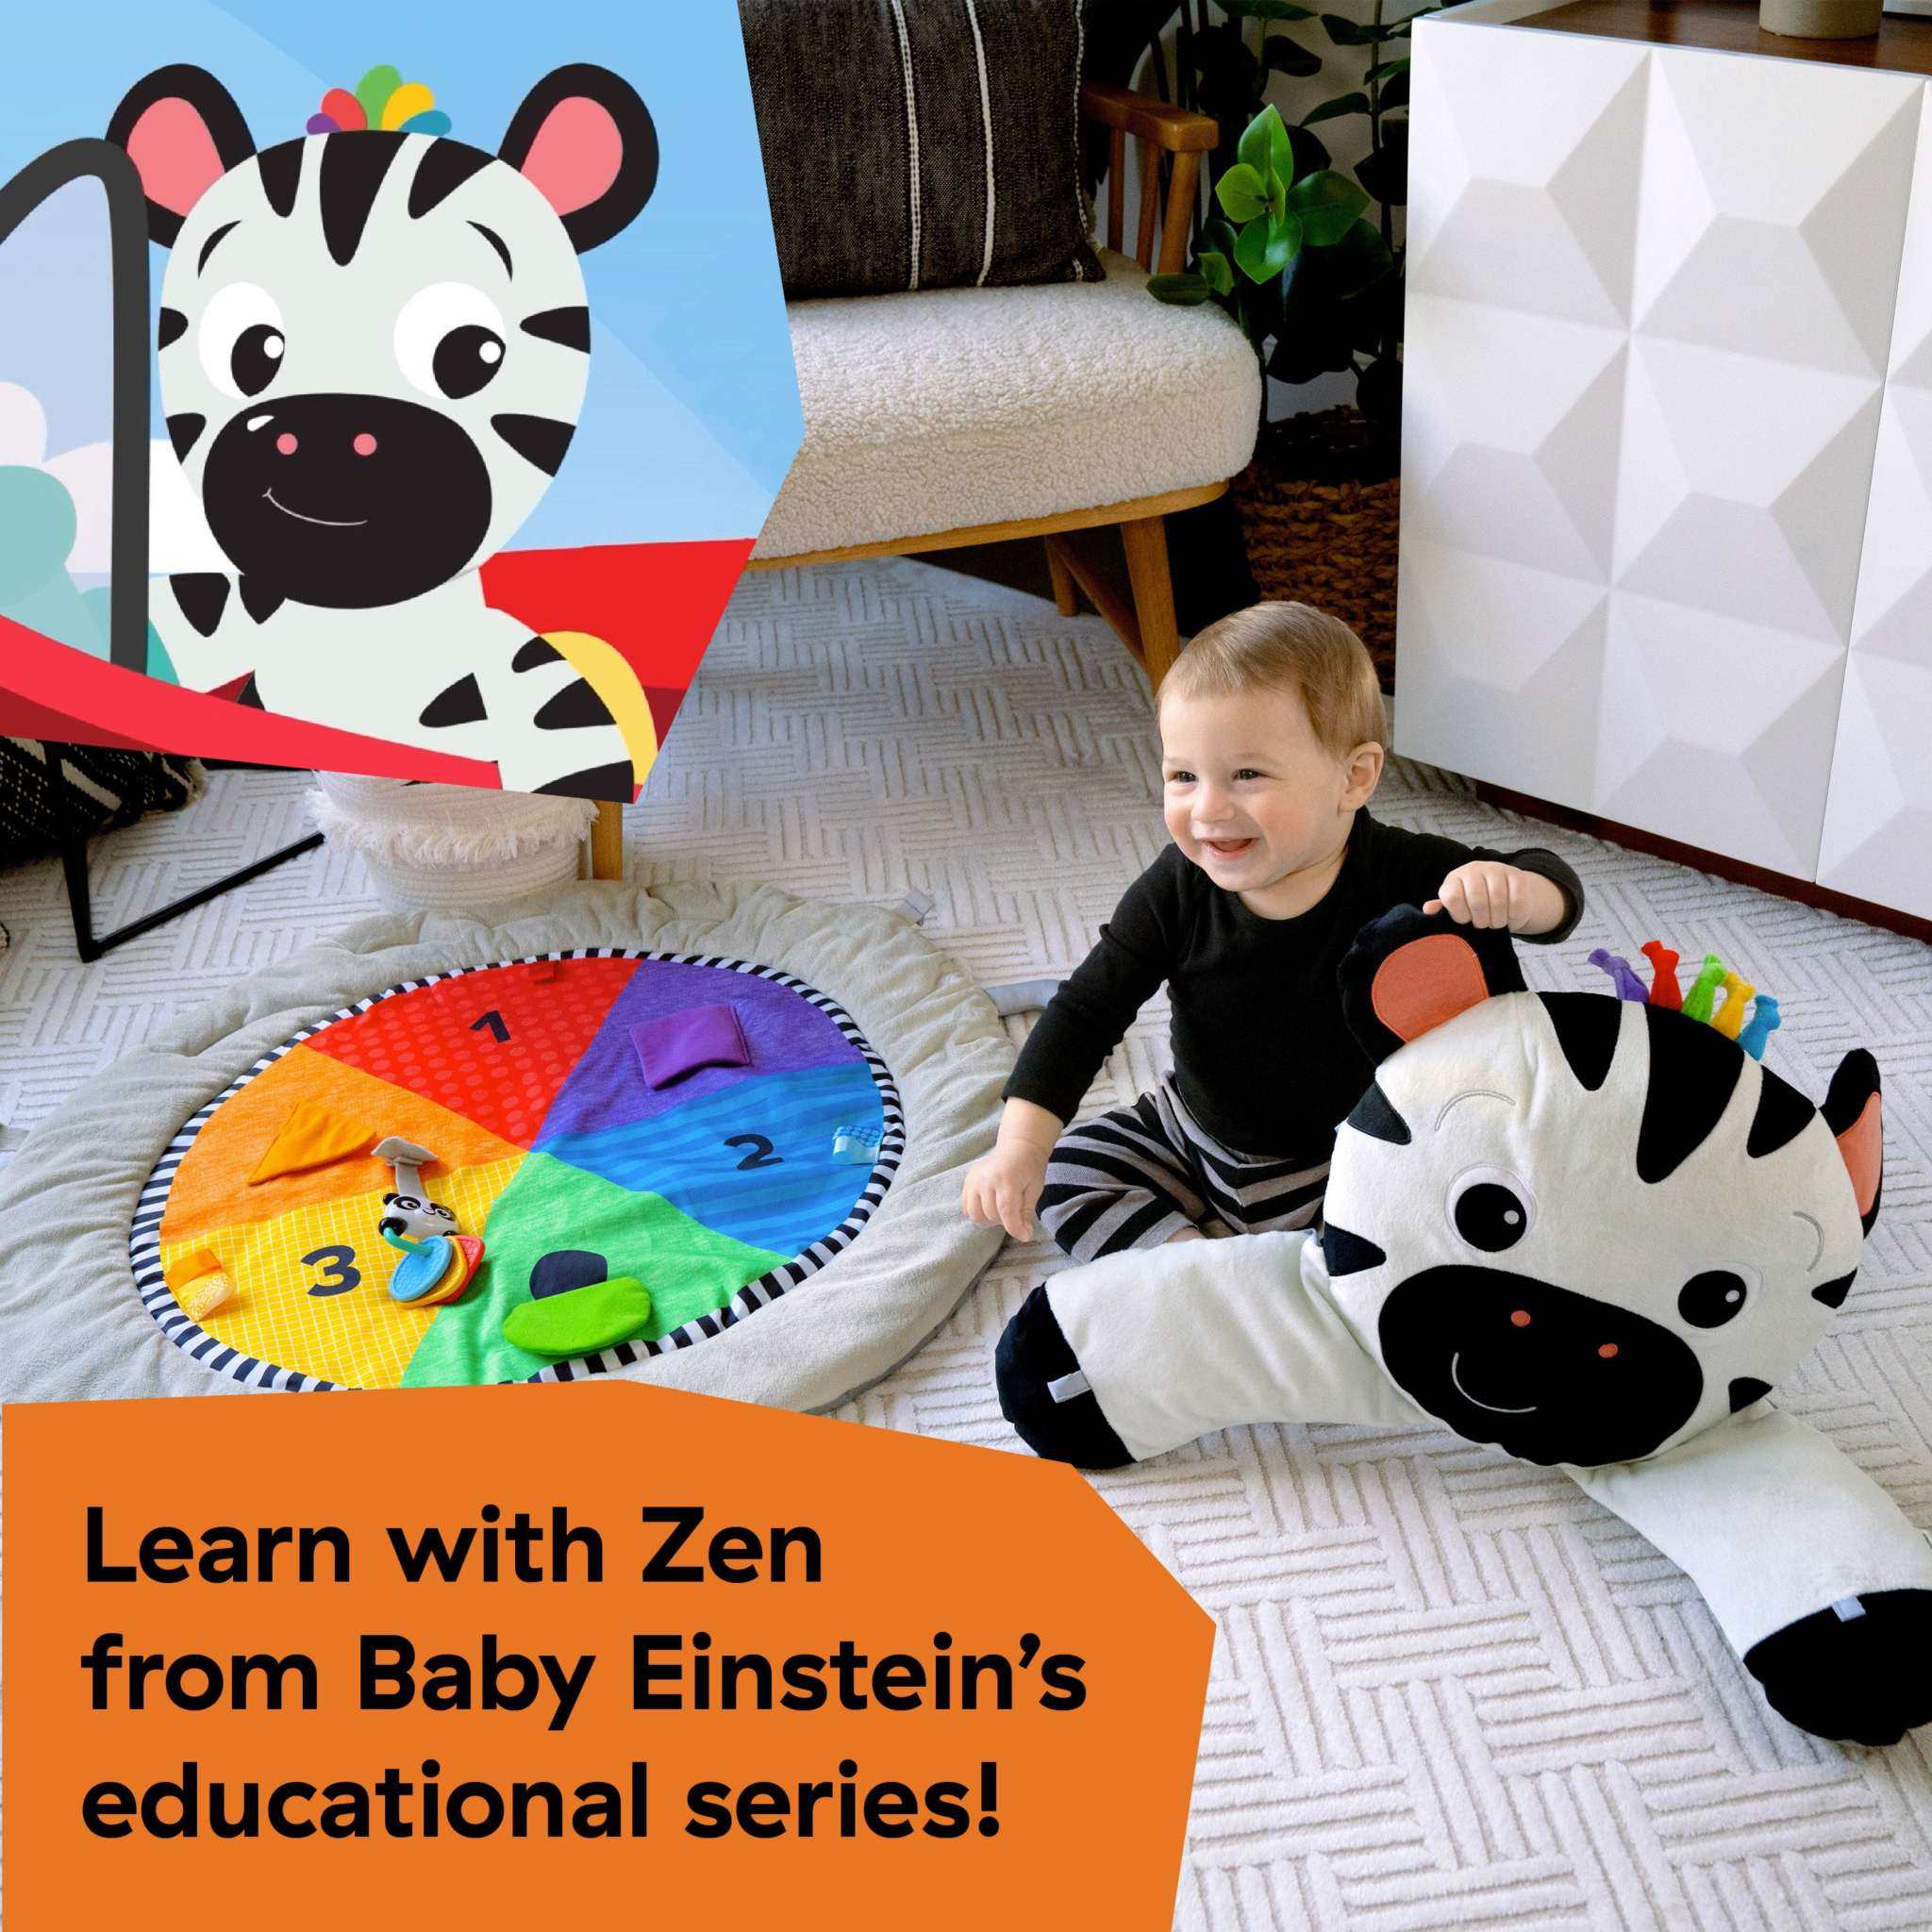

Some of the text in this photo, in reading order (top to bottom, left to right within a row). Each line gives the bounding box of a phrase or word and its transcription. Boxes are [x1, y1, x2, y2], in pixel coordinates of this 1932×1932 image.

[468, 1009, 511, 1043] 1
[723, 1134, 785, 1172] 2
[300, 1244, 362, 1298] 3
